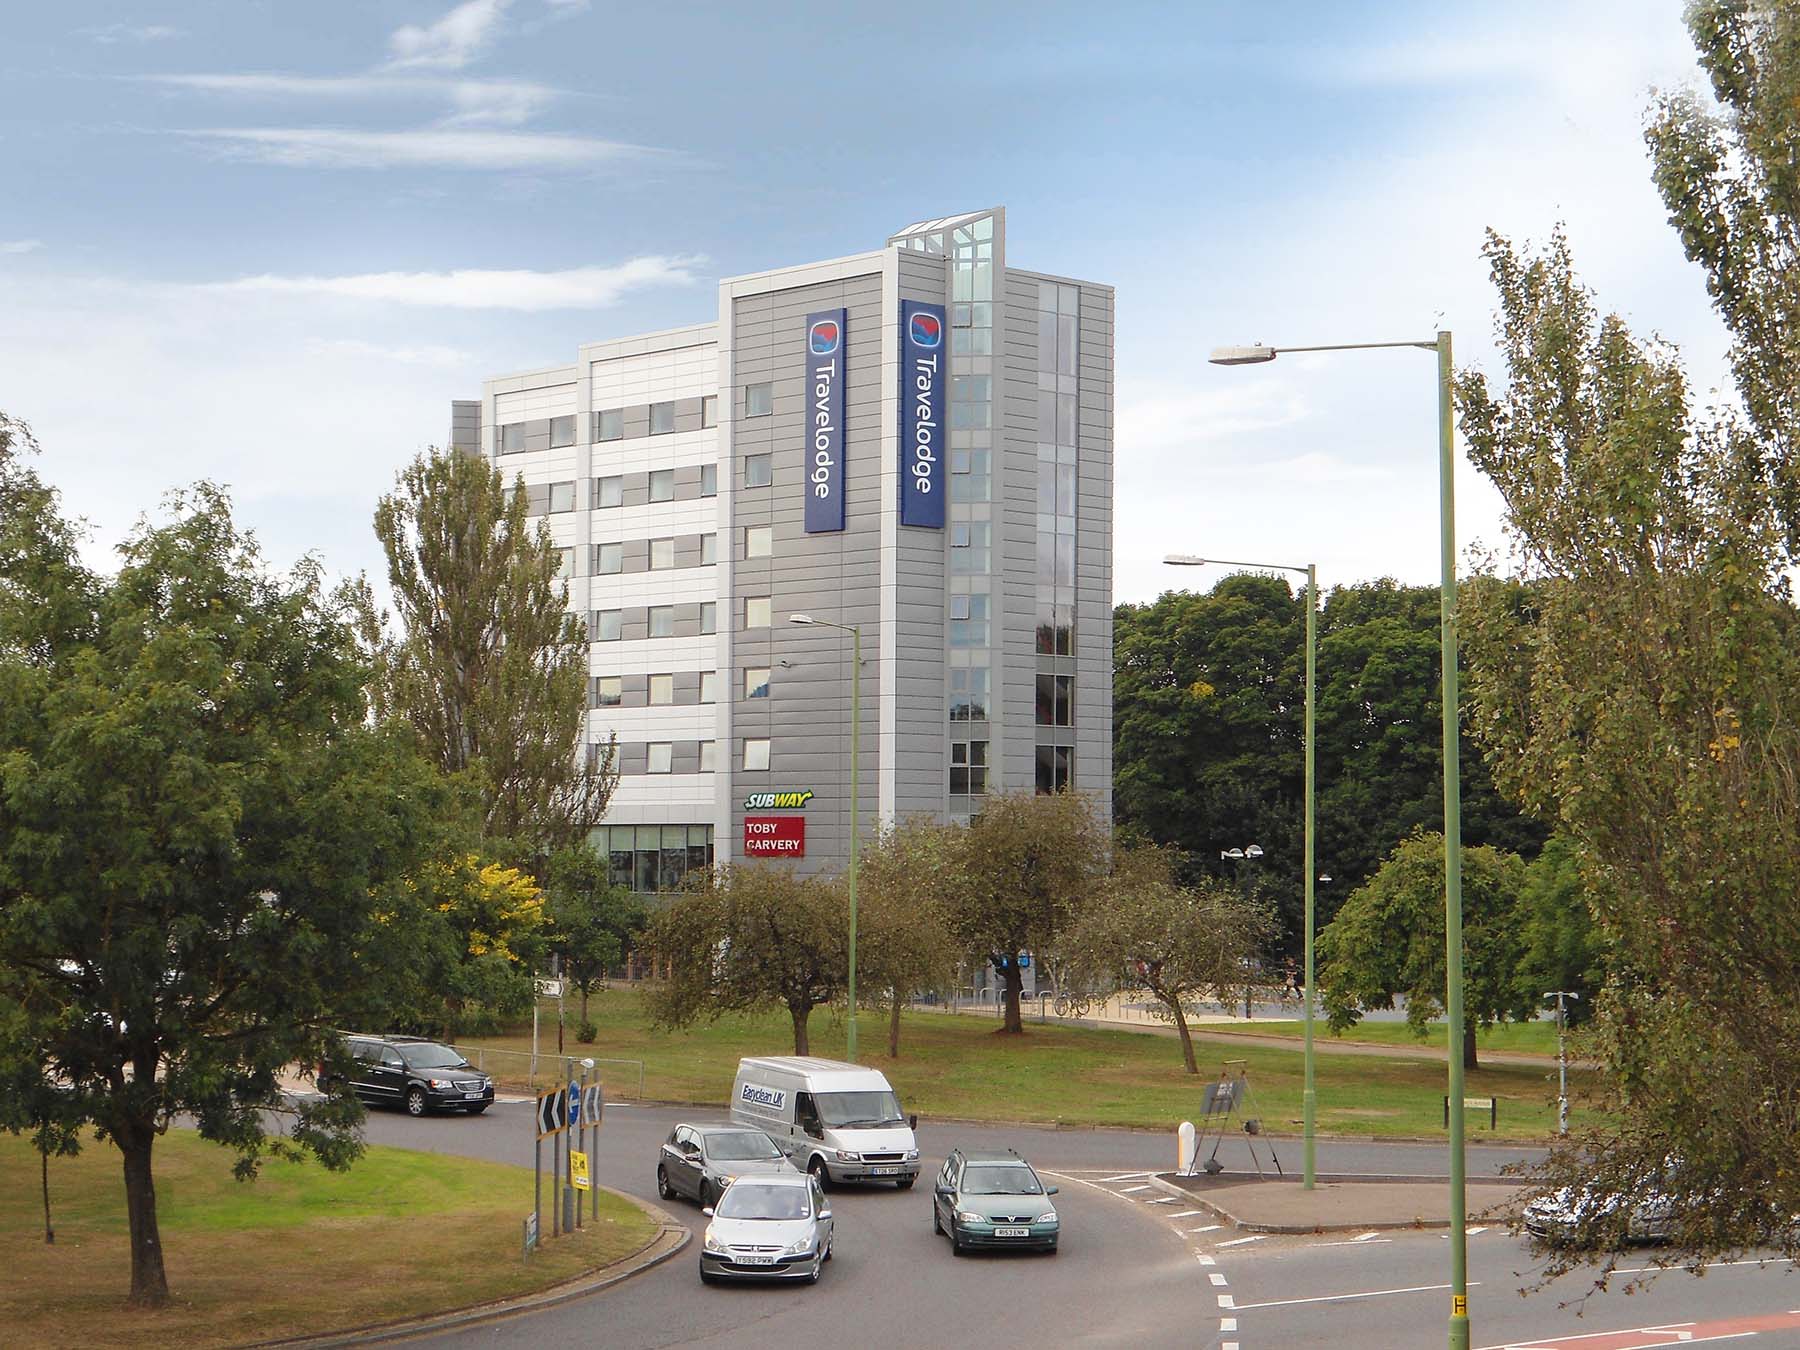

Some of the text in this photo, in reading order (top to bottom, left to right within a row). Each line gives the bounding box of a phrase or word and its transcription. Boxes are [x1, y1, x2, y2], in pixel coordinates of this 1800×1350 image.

[811, 358, 835, 499] Travelodge
[911, 354, 937, 494] Travelodge
[745, 791, 813, 809] SUBWAY
[746, 823, 777, 834] TOBY
[746, 839, 800, 850] CARVERY
[742, 1085, 785, 1105] Easyclean UK
[1455, 1297, 1466, 1314] H
